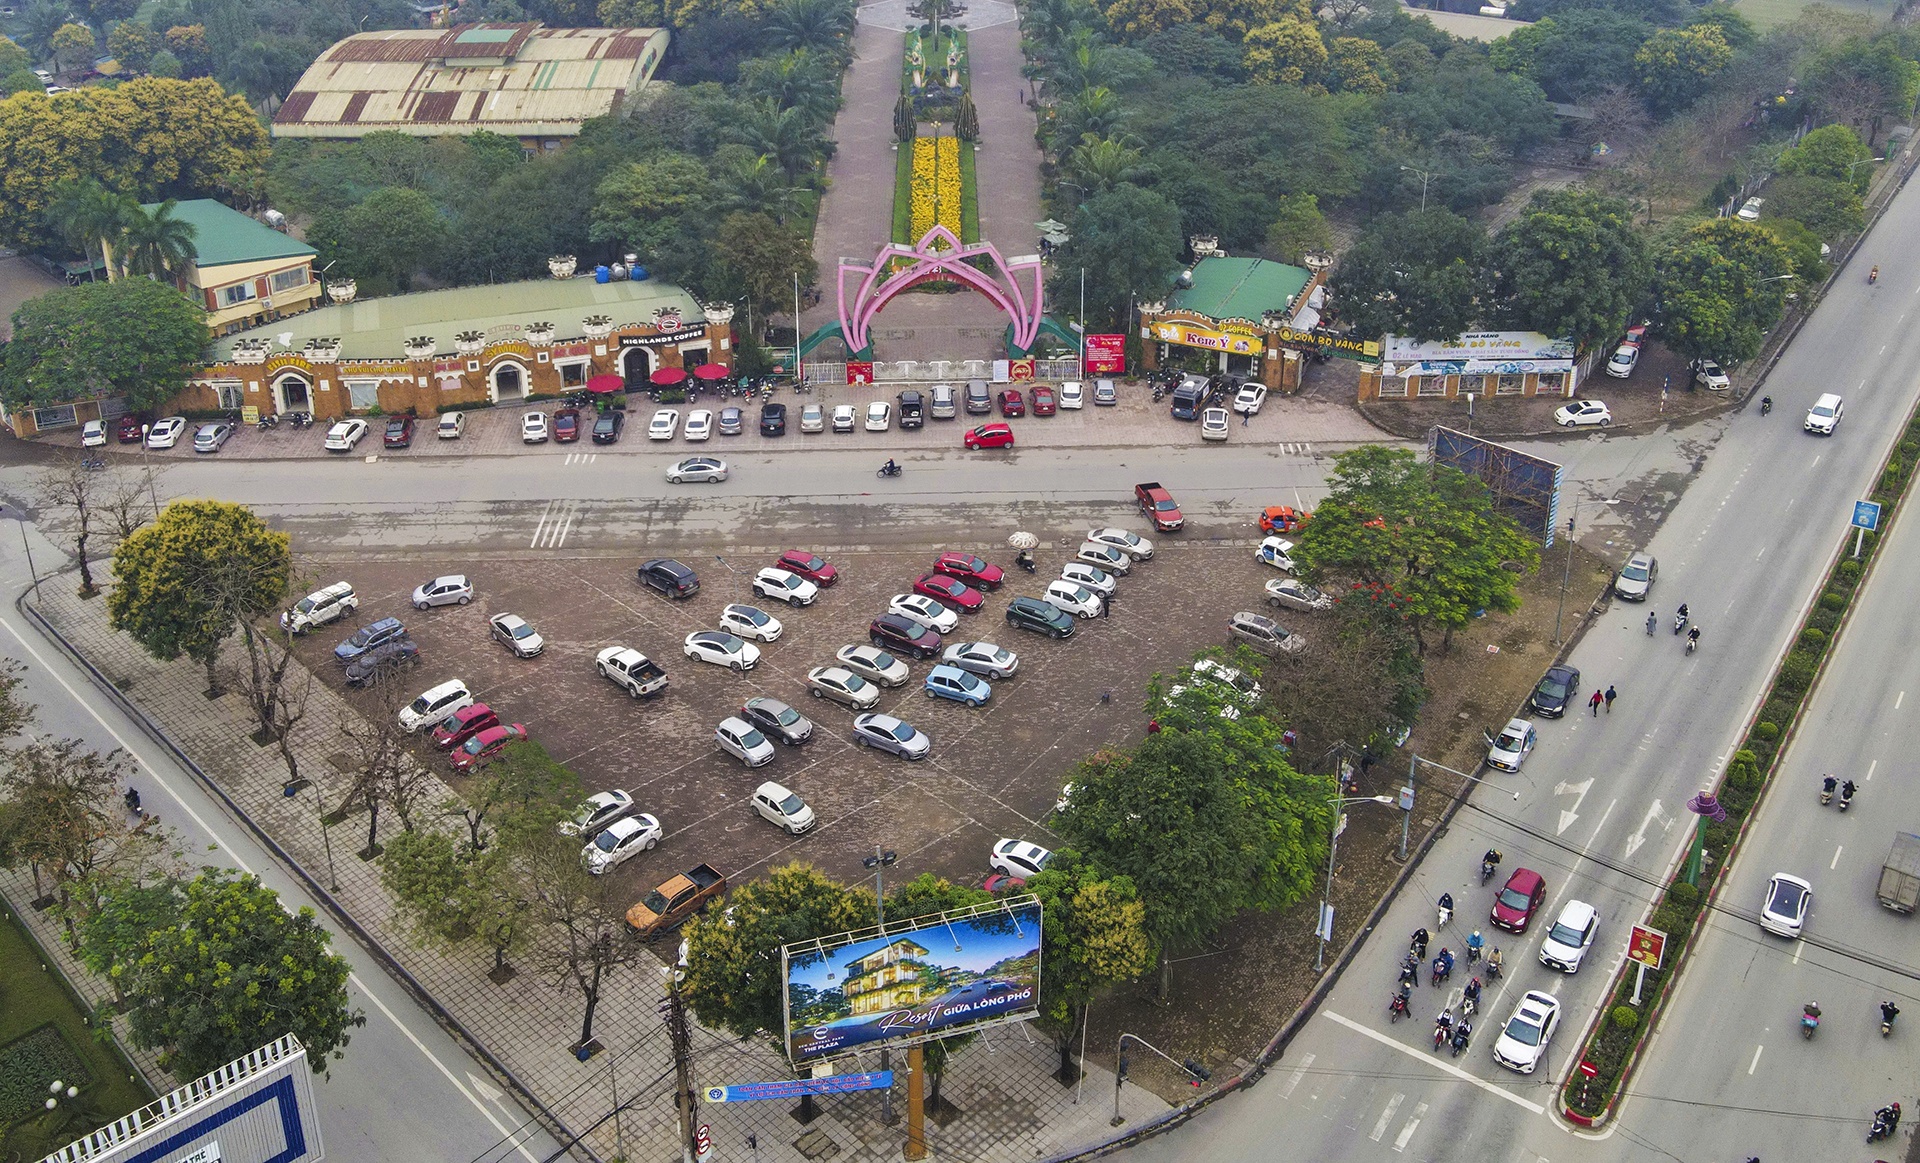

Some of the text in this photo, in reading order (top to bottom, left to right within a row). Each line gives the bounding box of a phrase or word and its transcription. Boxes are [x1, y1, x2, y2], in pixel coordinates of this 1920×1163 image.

[622, 330, 703, 346] HIGHLANDS COFFEE
[1228, 325, 1253, 336] COFFEE
[1186, 332, 1217, 348] Kem
[1294, 332, 1315, 343] CON
[1318, 334, 1333, 346] BÒ
[1335, 337, 1364, 352] VÀNG
[878, 986, 1032, 1034] Resort GIỮA LÒNG PHỐ
[804, 1041, 839, 1053] THE PLAZA
